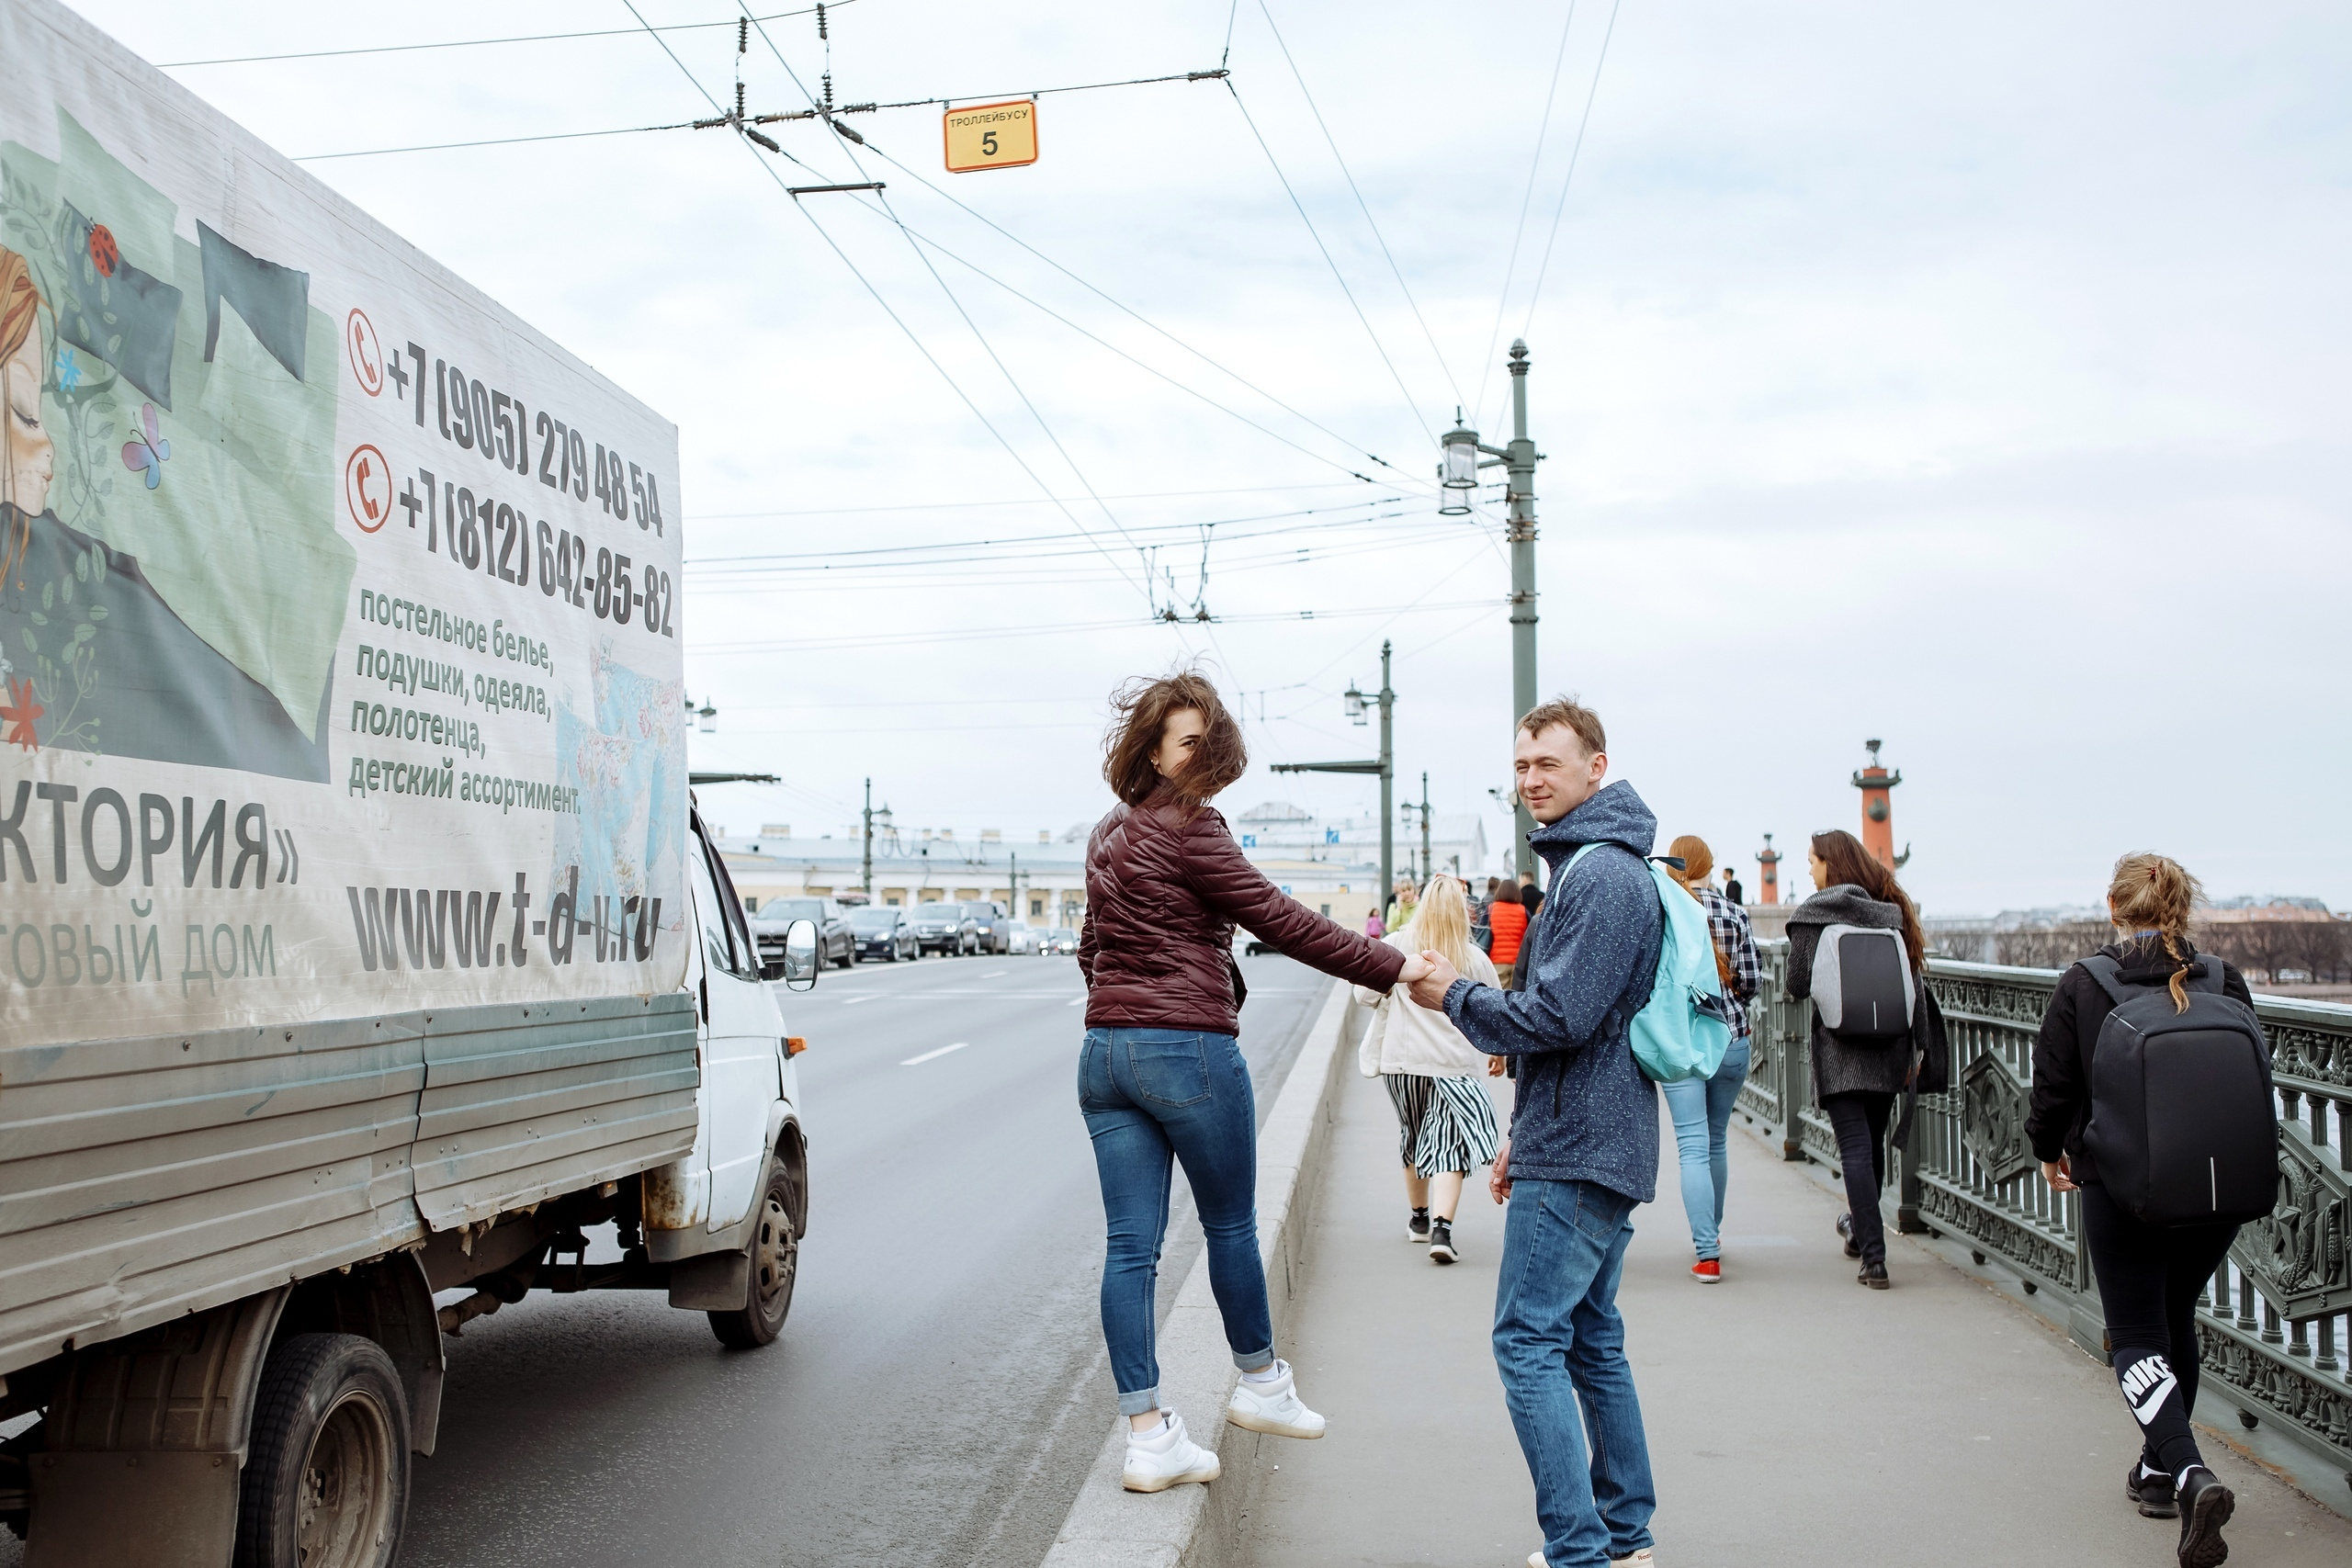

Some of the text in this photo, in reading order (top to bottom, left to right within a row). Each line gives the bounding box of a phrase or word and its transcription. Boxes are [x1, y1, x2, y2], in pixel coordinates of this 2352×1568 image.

[949, 109, 1028, 128] ТРОЛЛЕЙБУСУ
[982, 130, 999, 156] 5
[387, 340, 663, 538] +7 (905) 279 48 54
[400, 467, 674, 639] +7 (812) 642-85-82
[360, 588, 554, 677] постельное белье,
[356, 644, 551, 723] подушки, одеяла,
[351, 701, 486, 759] полотенца,
[348, 757, 582, 815] детский ассортимент.
[0, 897, 277, 998] ОВЫЙ ДОМ
[345, 864, 662, 972] www.t-d-v.ru
[2121, 1355, 2172, 1407] NIKE
